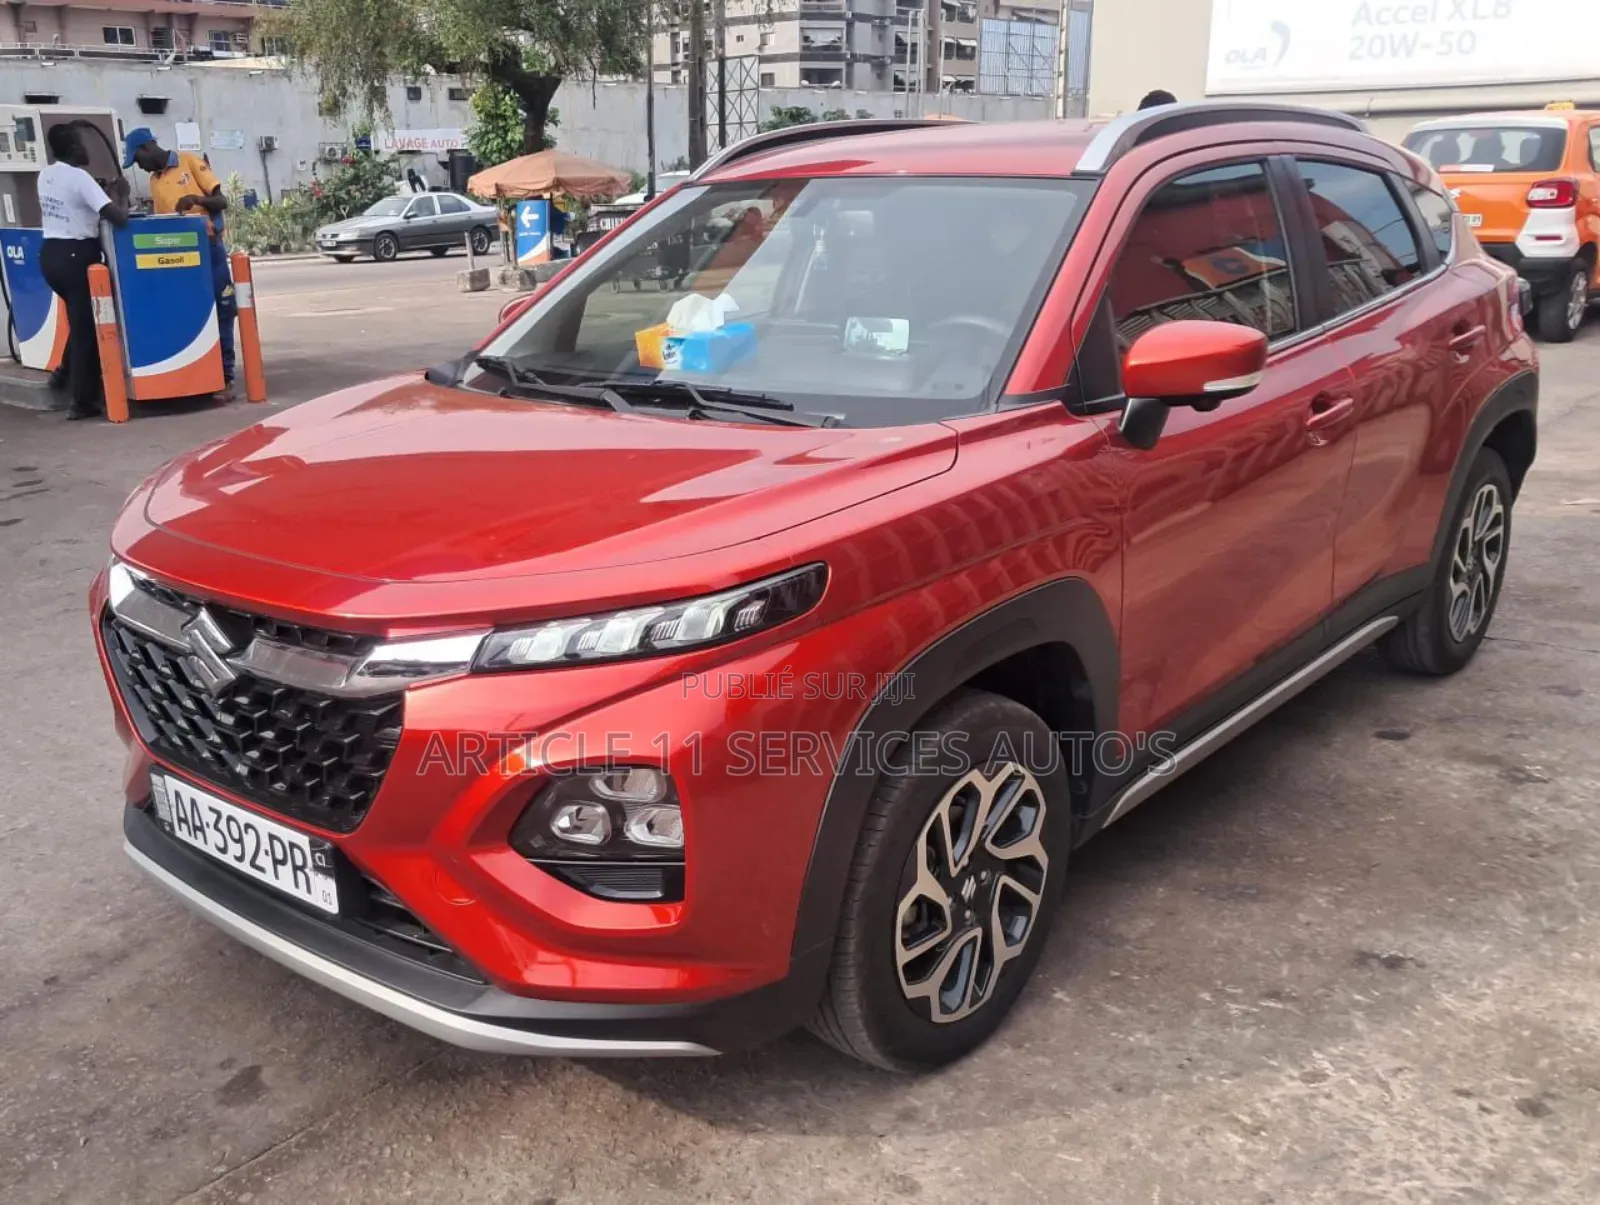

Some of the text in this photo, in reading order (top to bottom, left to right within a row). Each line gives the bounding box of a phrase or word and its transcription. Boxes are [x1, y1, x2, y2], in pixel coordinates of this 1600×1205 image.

[1350, 0, 1439, 27] Accel
[1347, 29, 1477, 62] 20W-50
[384, 137, 428, 149] LAVAGE
[7, 245, 25, 259] OLA
